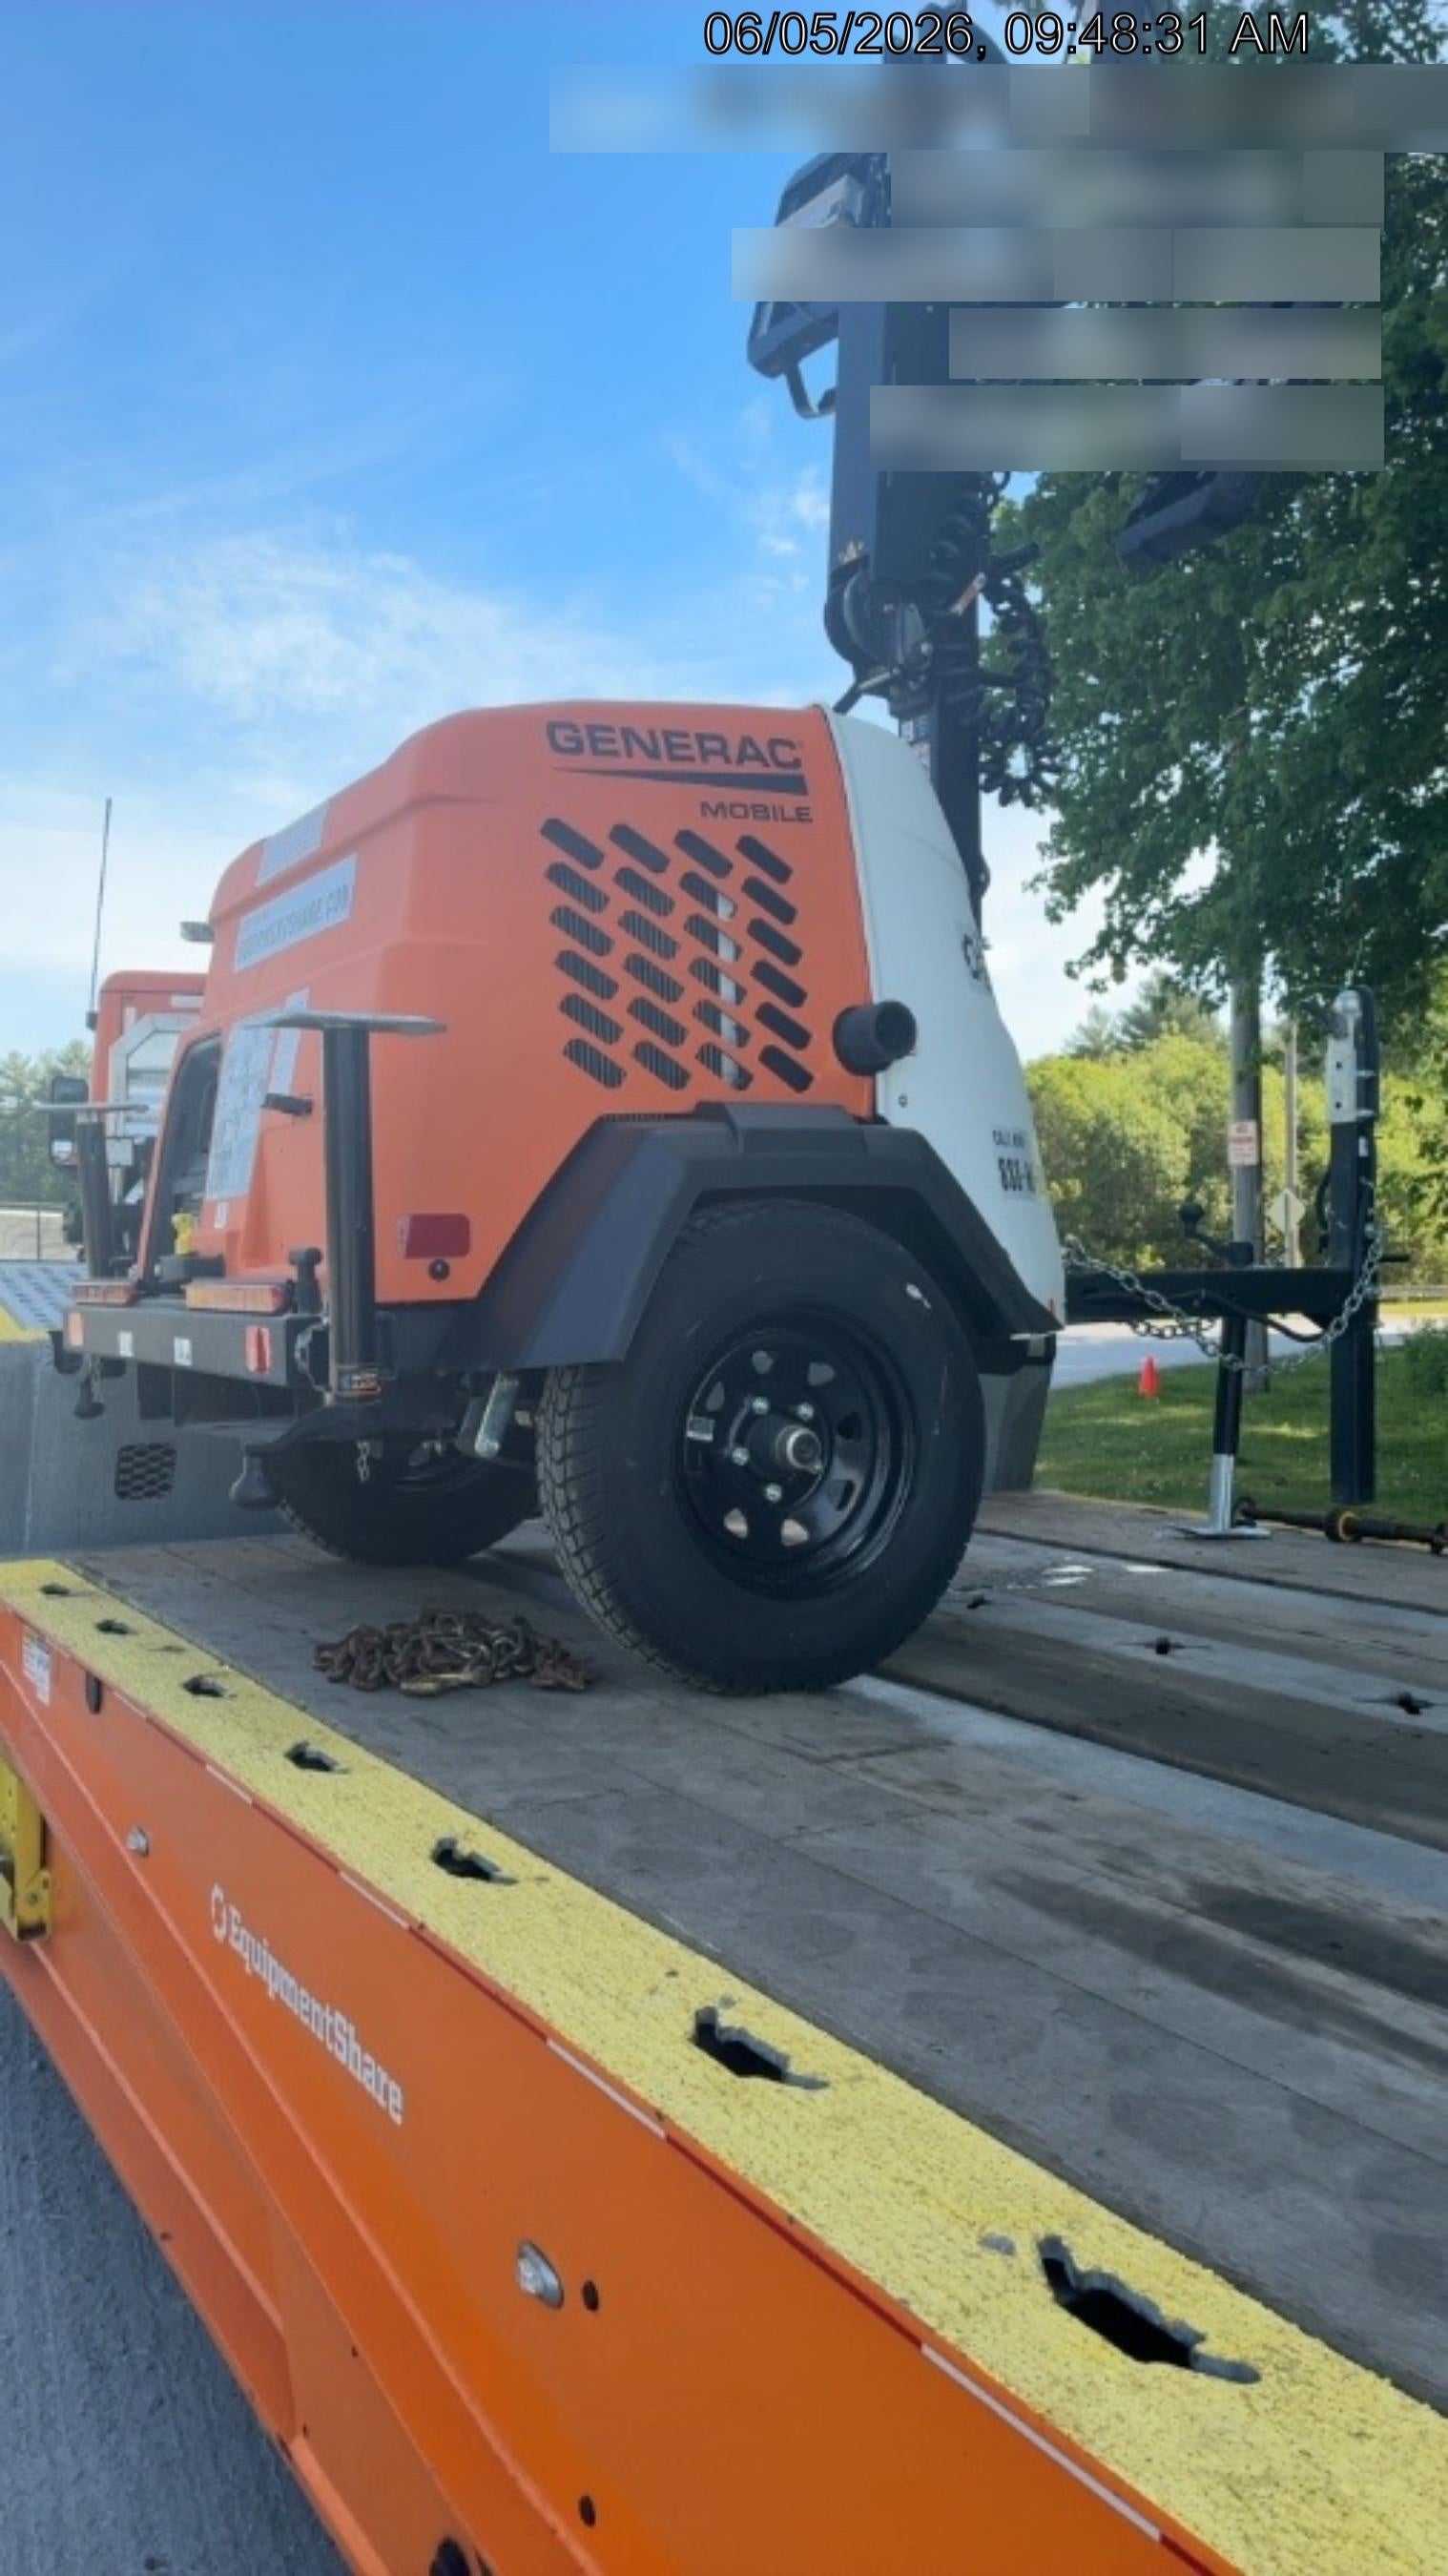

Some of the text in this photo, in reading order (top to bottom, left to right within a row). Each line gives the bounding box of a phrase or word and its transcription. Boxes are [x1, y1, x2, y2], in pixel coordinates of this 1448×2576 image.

[546, 720, 802, 769] GENERAC
[700, 800, 813, 823] MOBILE
[228, 1904, 403, 2127] EquipmentShare
